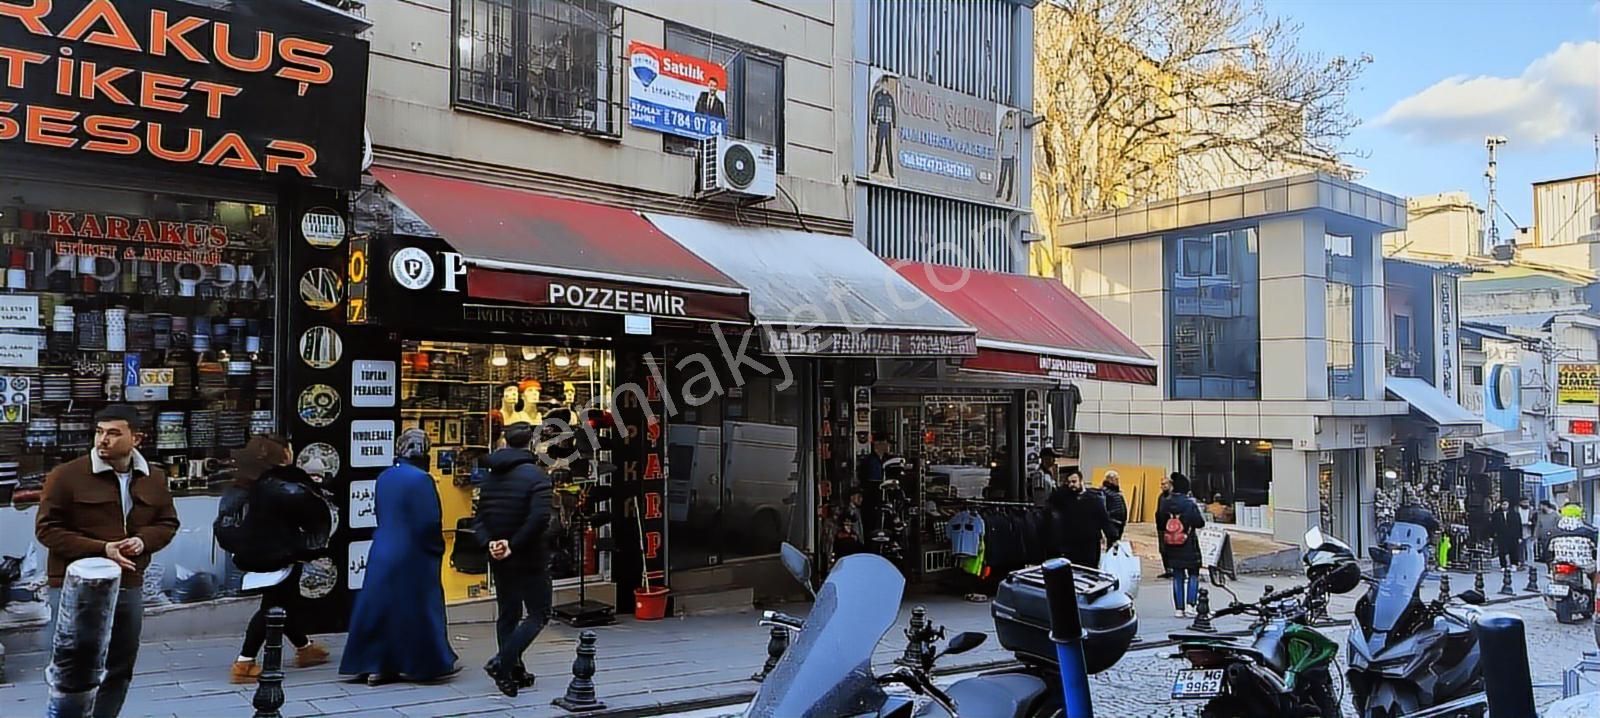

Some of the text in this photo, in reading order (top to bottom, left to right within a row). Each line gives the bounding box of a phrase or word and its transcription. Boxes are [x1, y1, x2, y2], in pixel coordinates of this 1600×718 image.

[663, 58, 705, 81] Satılık
[671, 110, 691, 129] 784
[694, 117, 707, 132] 07
[710, 120, 722, 136] 84
[123, 247, 136, 260] &
[549, 283, 687, 316] POZZEEMİR
[832, 333, 901, 354] FERMUAR
[1186, 681, 1217, 692] 9962
